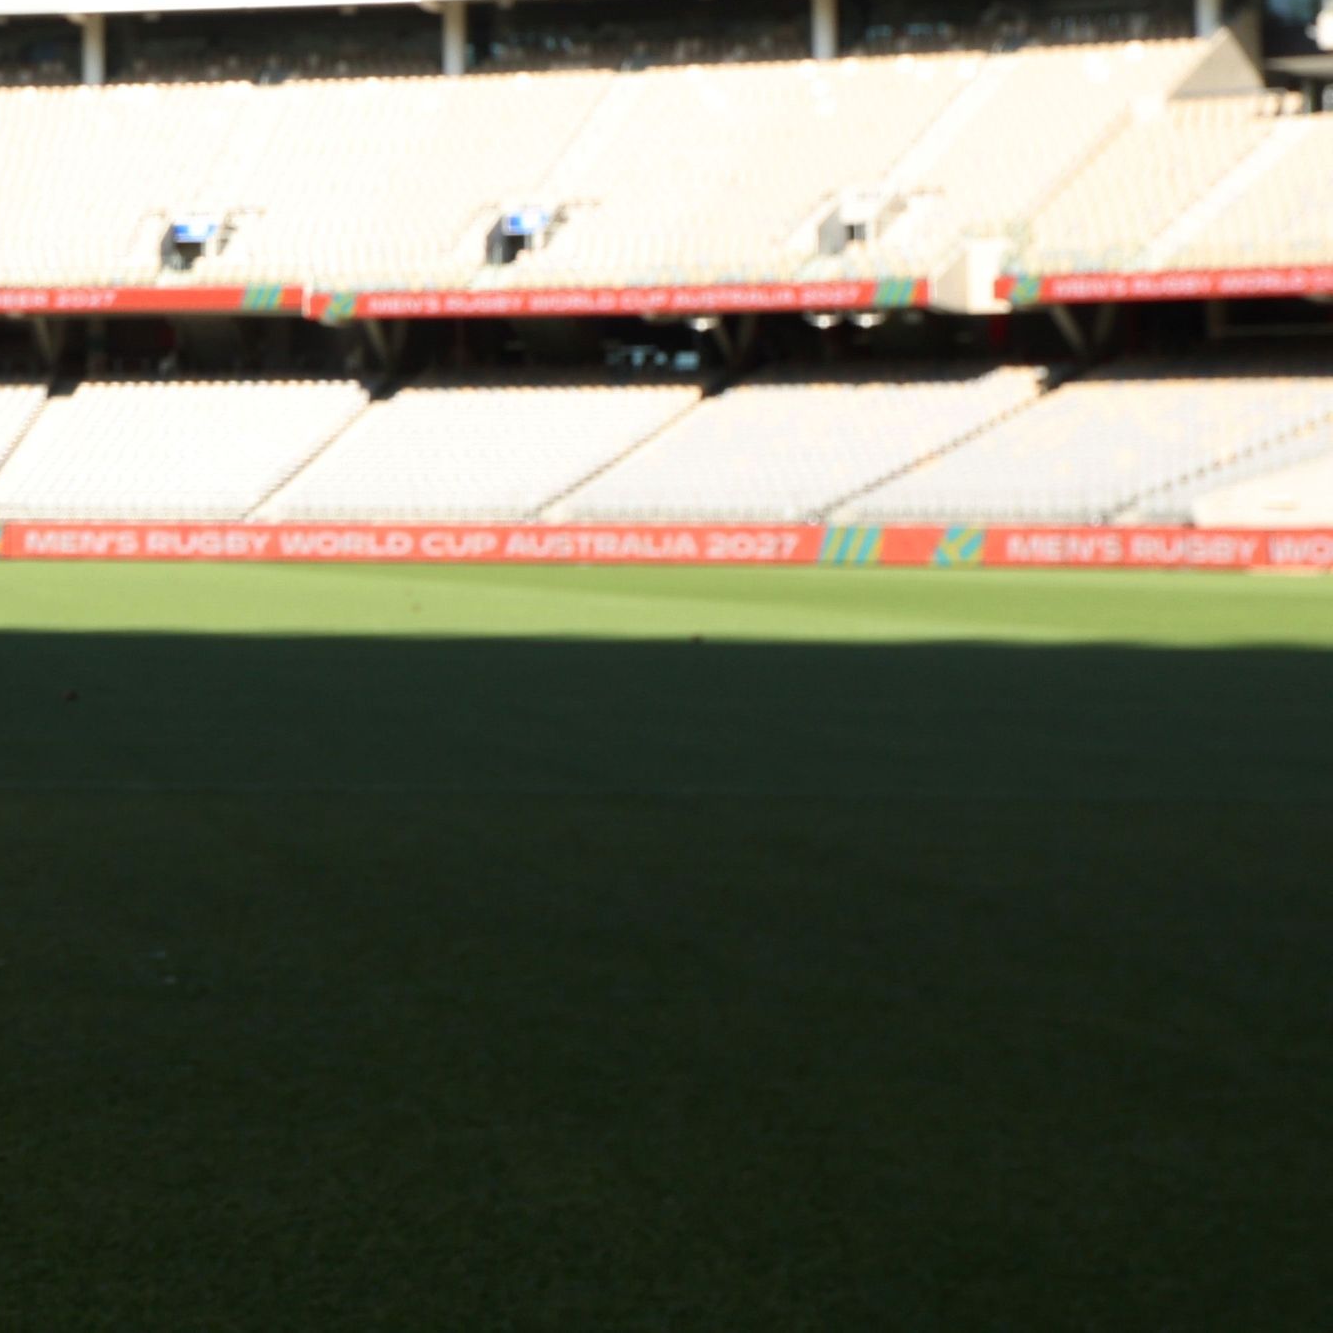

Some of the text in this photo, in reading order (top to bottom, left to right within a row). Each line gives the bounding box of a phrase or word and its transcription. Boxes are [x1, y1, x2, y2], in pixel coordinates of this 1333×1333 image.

[24, 530, 800, 558] MEN'S RUGBY WORLD CUP AUSTRALIA 2027
[1006, 534, 1122, 562] MEN'S
[1130, 534, 1256, 563] RUGBY
